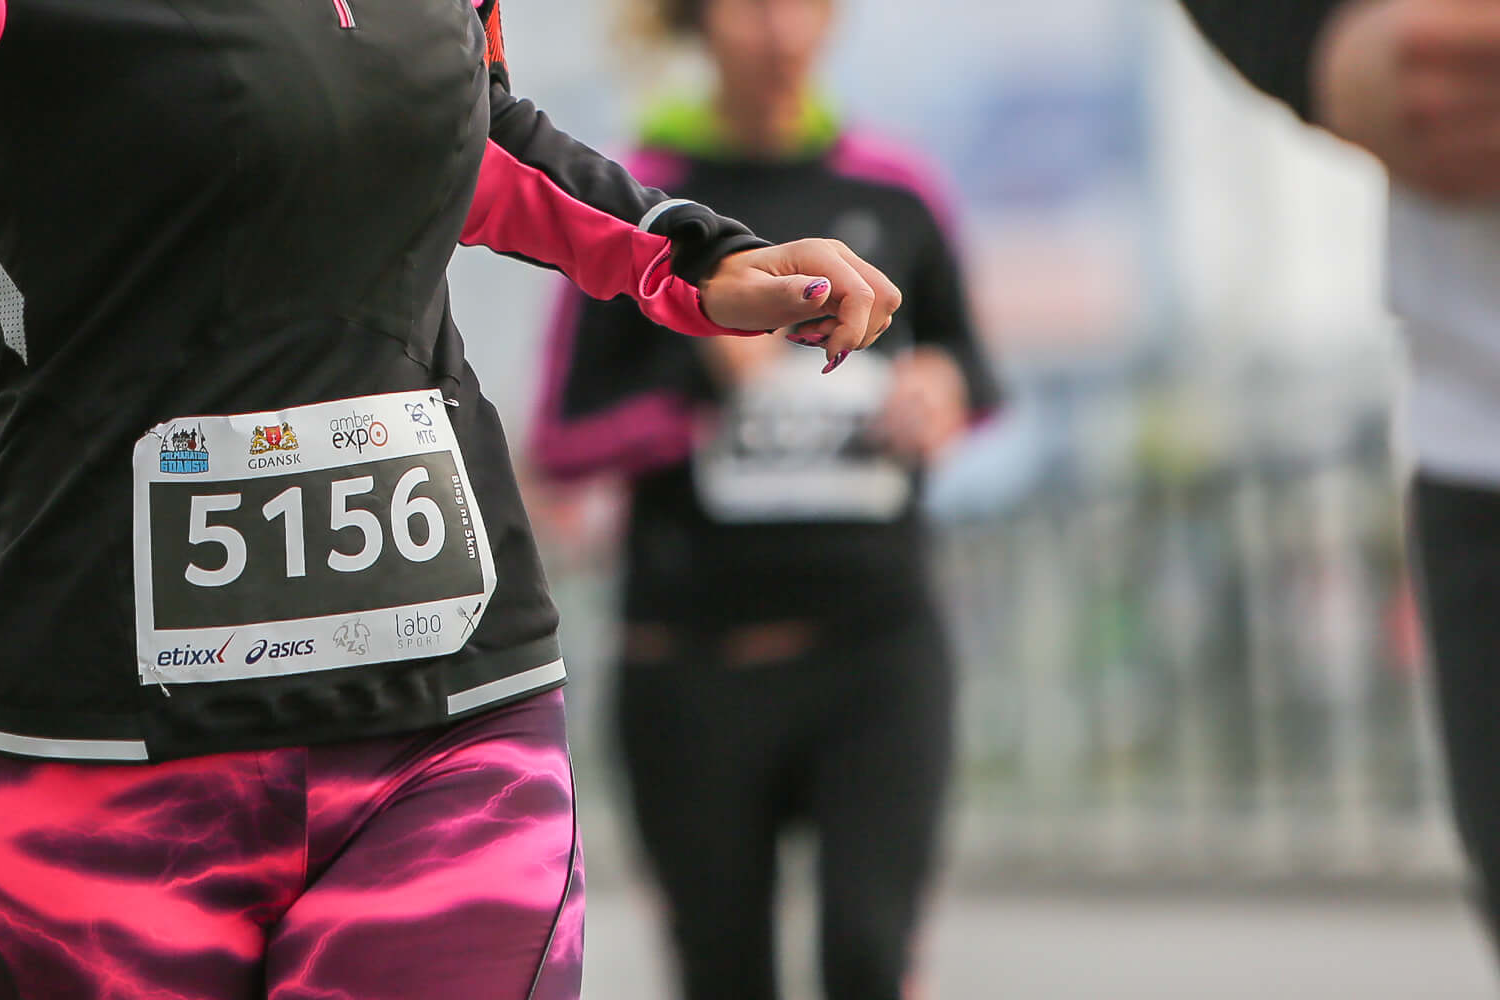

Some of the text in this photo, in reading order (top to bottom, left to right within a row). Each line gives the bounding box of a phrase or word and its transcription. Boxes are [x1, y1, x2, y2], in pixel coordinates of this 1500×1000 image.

[329, 411, 374, 432] amber
[416, 429, 437, 445] MTG
[184, 466, 446, 587] 5156
[451, 474, 476, 559] Bieg na 5km
[395, 609, 441, 637] labo
[397, 635, 441, 649] SPORT
[157, 643, 217, 666] etixx
